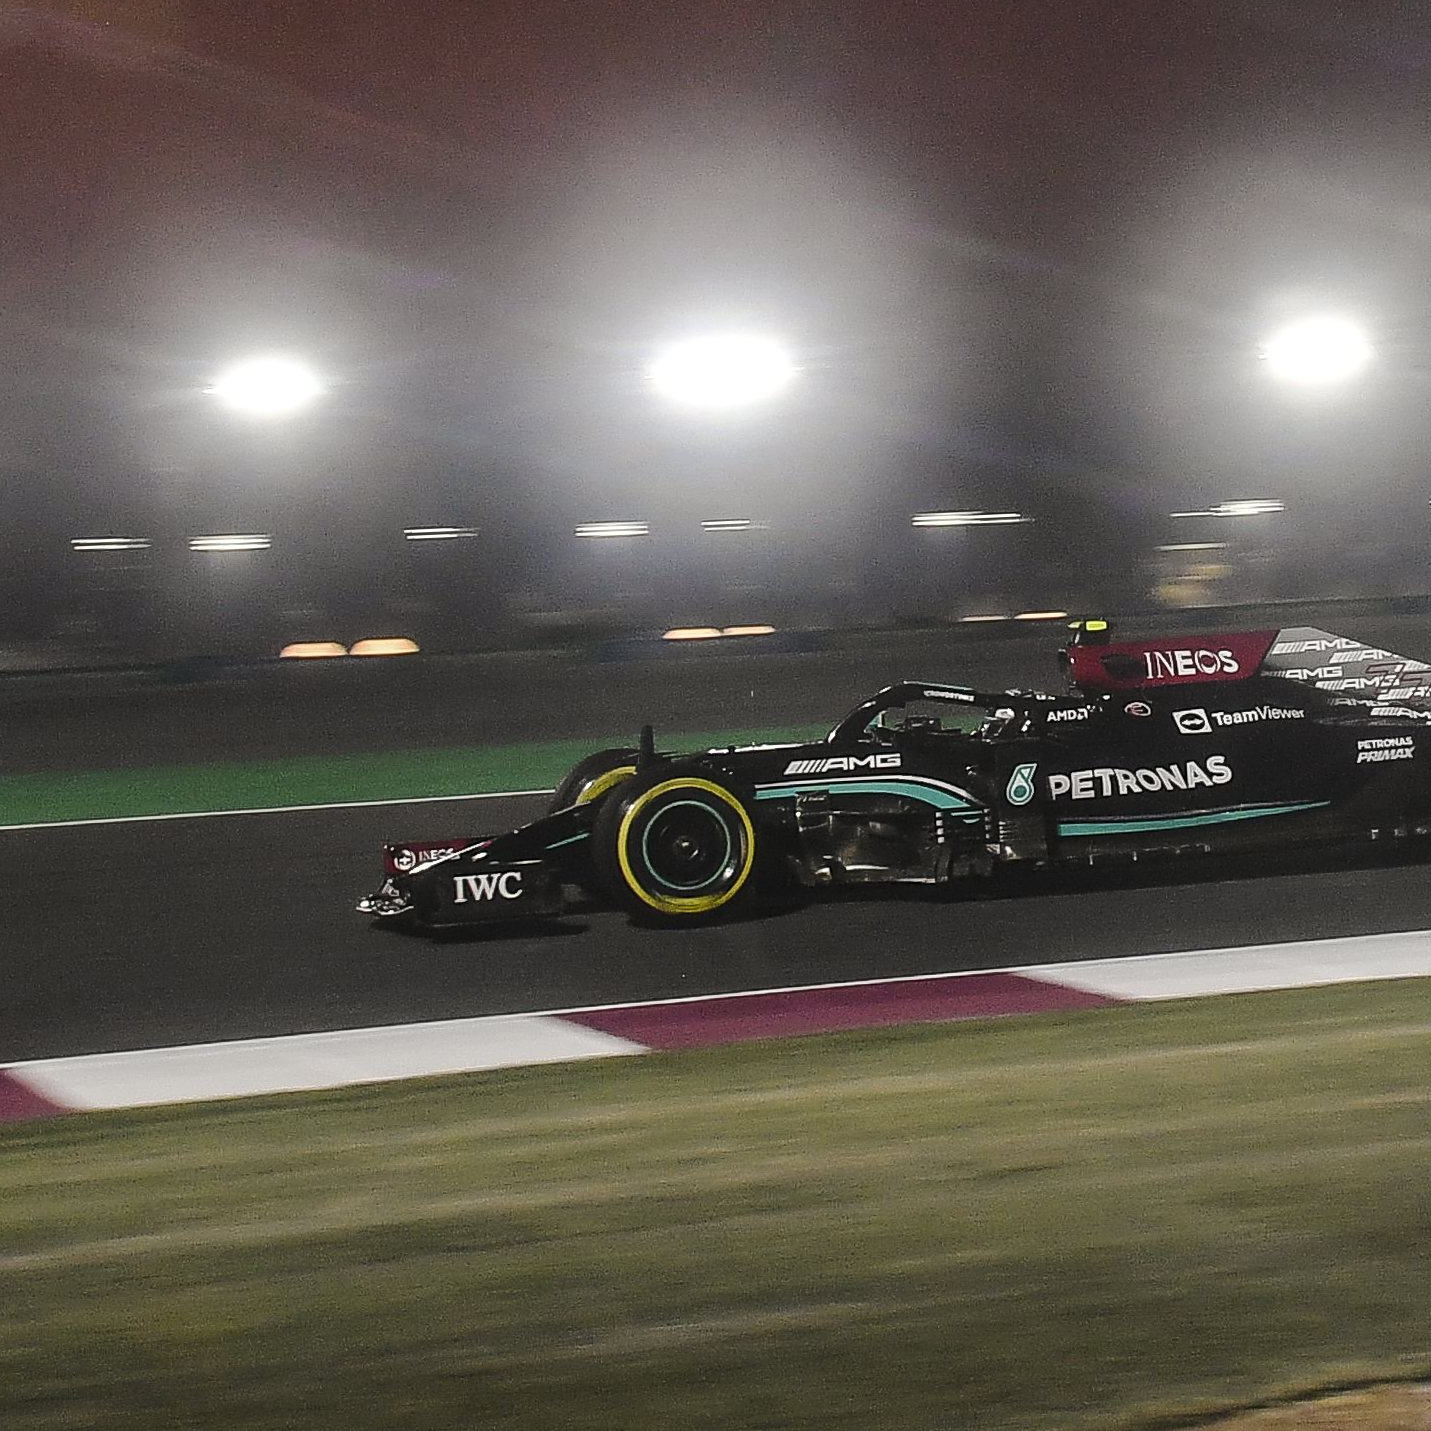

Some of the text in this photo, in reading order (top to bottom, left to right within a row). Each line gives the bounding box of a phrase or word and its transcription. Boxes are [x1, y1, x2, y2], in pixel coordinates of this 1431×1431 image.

[1143, 649, 1240, 680] INEOS
[1285, 666, 1343, 680] AMG
[1047, 709, 1078, 723] AMD
[1211, 705, 1305, 727] TeamViewer
[1357, 736, 1413, 750] PETRONAS
[822, 753, 902, 773] AMG
[1356, 746, 1416, 764] PRIMAX
[1048, 755, 1233, 801] PETRONAS
[453, 872, 523, 904] IWC
